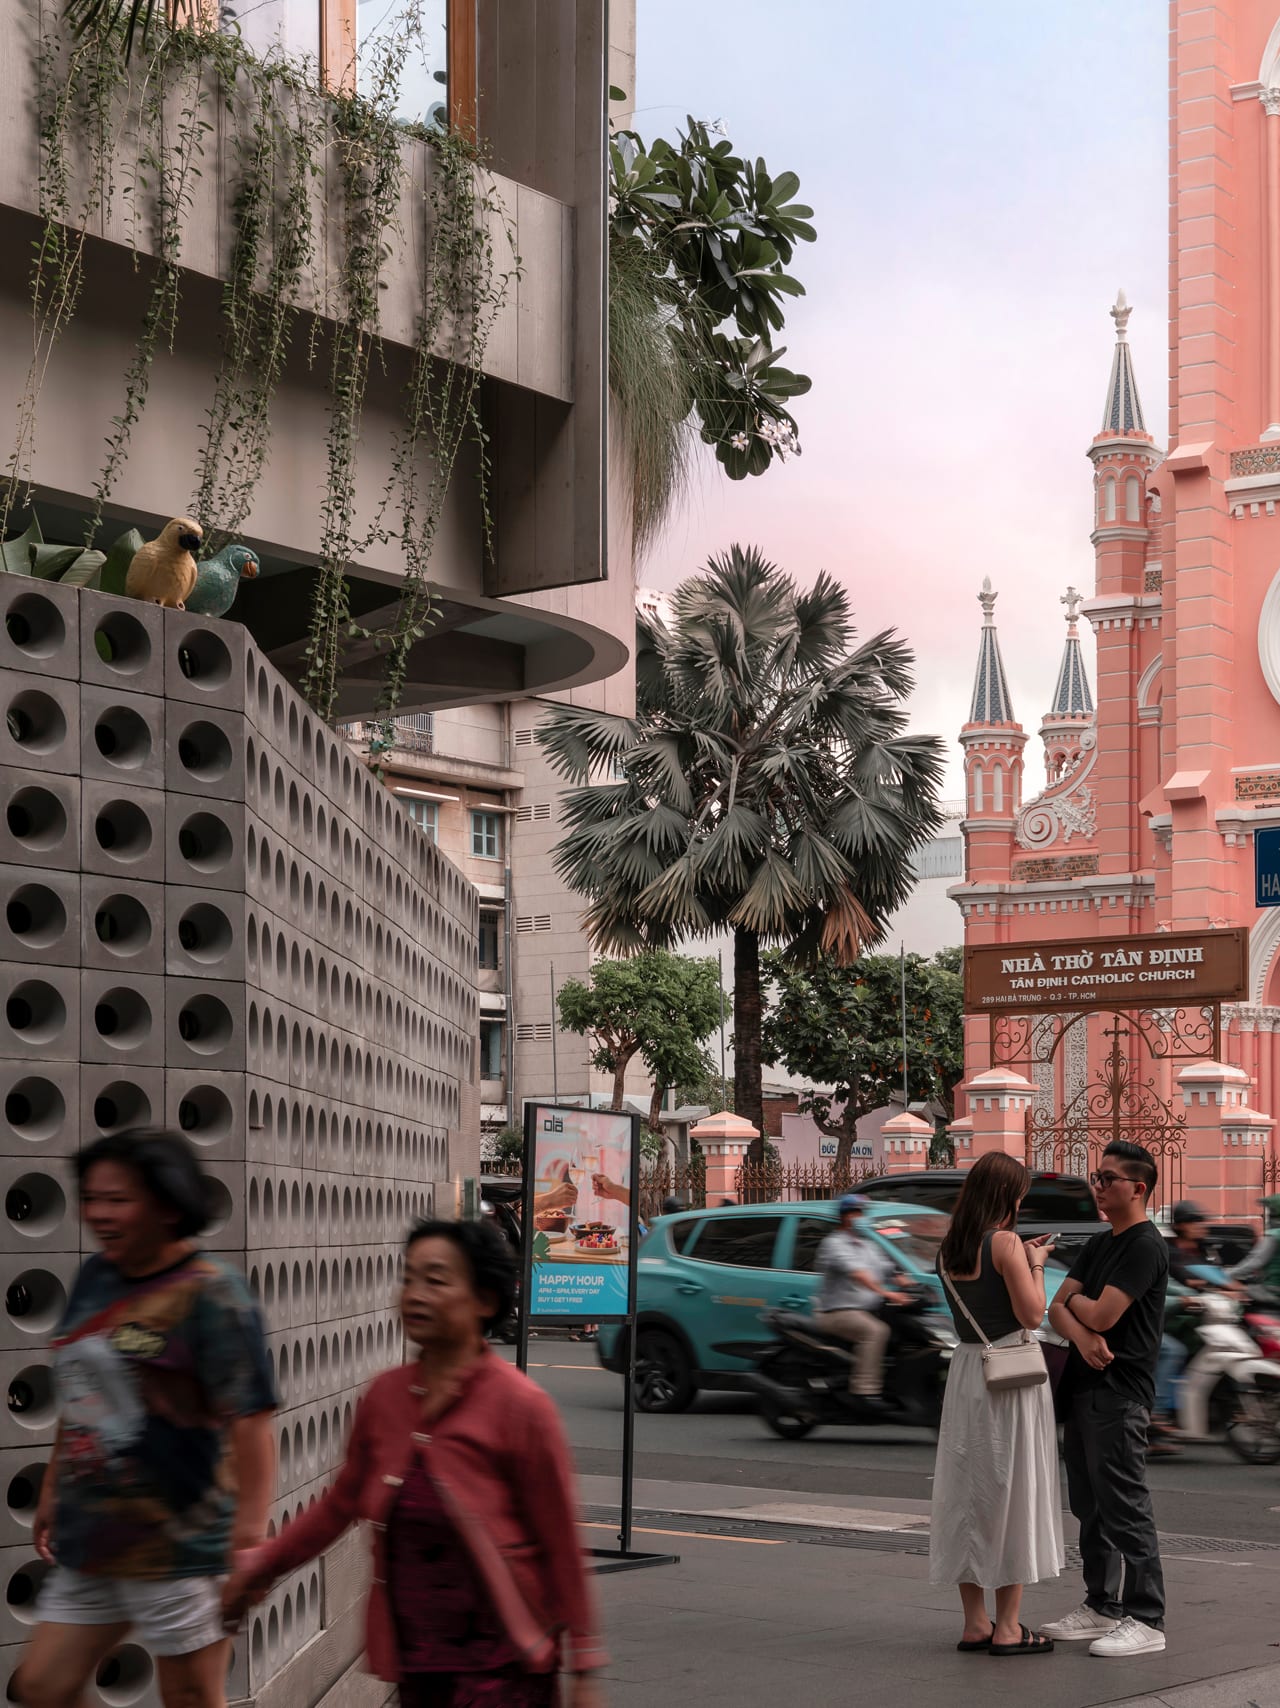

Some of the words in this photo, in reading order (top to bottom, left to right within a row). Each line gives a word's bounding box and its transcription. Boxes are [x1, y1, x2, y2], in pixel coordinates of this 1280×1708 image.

[1001, 952, 1046, 974] NHÀ
[1051, 949, 1094, 971] THỜ
[1100, 948, 1144, 968] TÂN
[1149, 947, 1204, 968] ĐỊNH
[1010, 977, 1034, 989] TÂN
[1037, 976, 1068, 989] ĐỊNH
[1071, 972, 1135, 986] CATHOLIC
[1138, 969, 1195, 982] CHURCH
[982, 996, 995, 1004] 289
[996, 995, 1007, 1003] HAI
[1007, 993, 1018, 1003] BÀ
[1018, 993, 1042, 1002] TRƯNG
[1080, 992, 1096, 1000] HCM
[822, 1142, 836, 1154] ĐỨC
[851, 1146, 861, 1155] AN
[539, 1274, 575, 1285] HAPPY
[576, 1275, 605, 1286] HOUR
